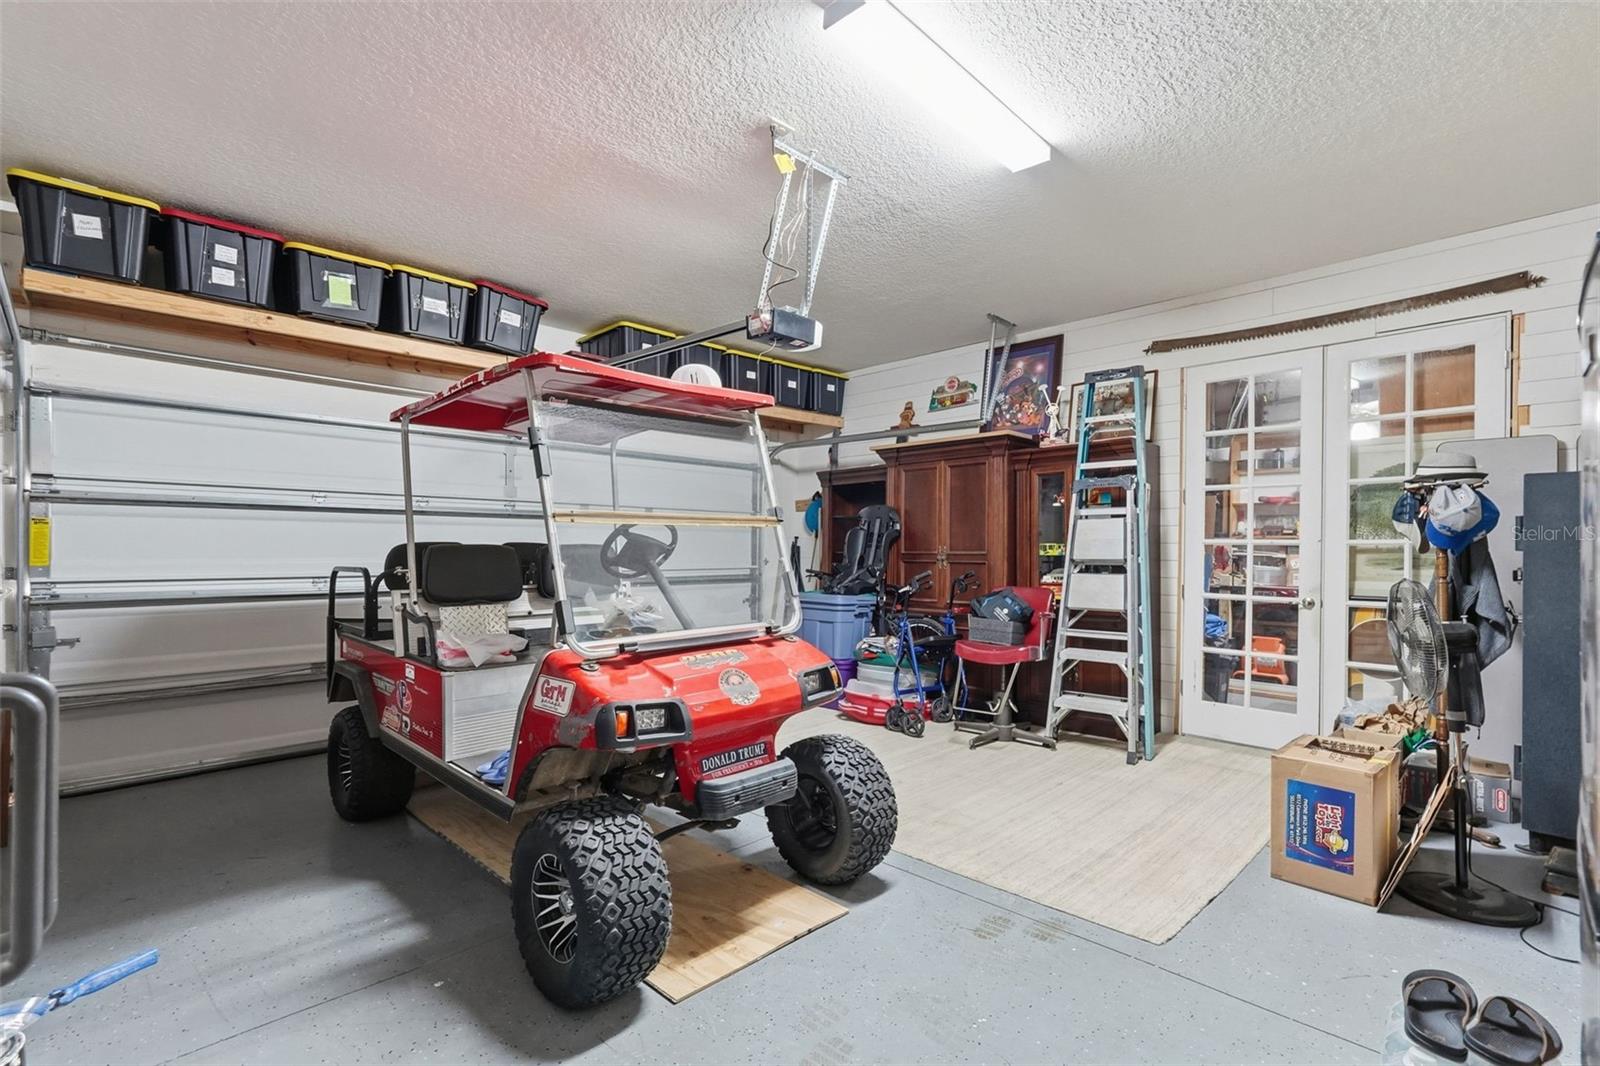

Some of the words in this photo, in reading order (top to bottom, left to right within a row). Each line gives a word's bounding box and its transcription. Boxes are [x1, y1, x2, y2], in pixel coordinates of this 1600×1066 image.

[702, 751, 737, 772] DONALD
[738, 743, 766, 760] TRUMP
[1330, 805, 1341, 830] Light
